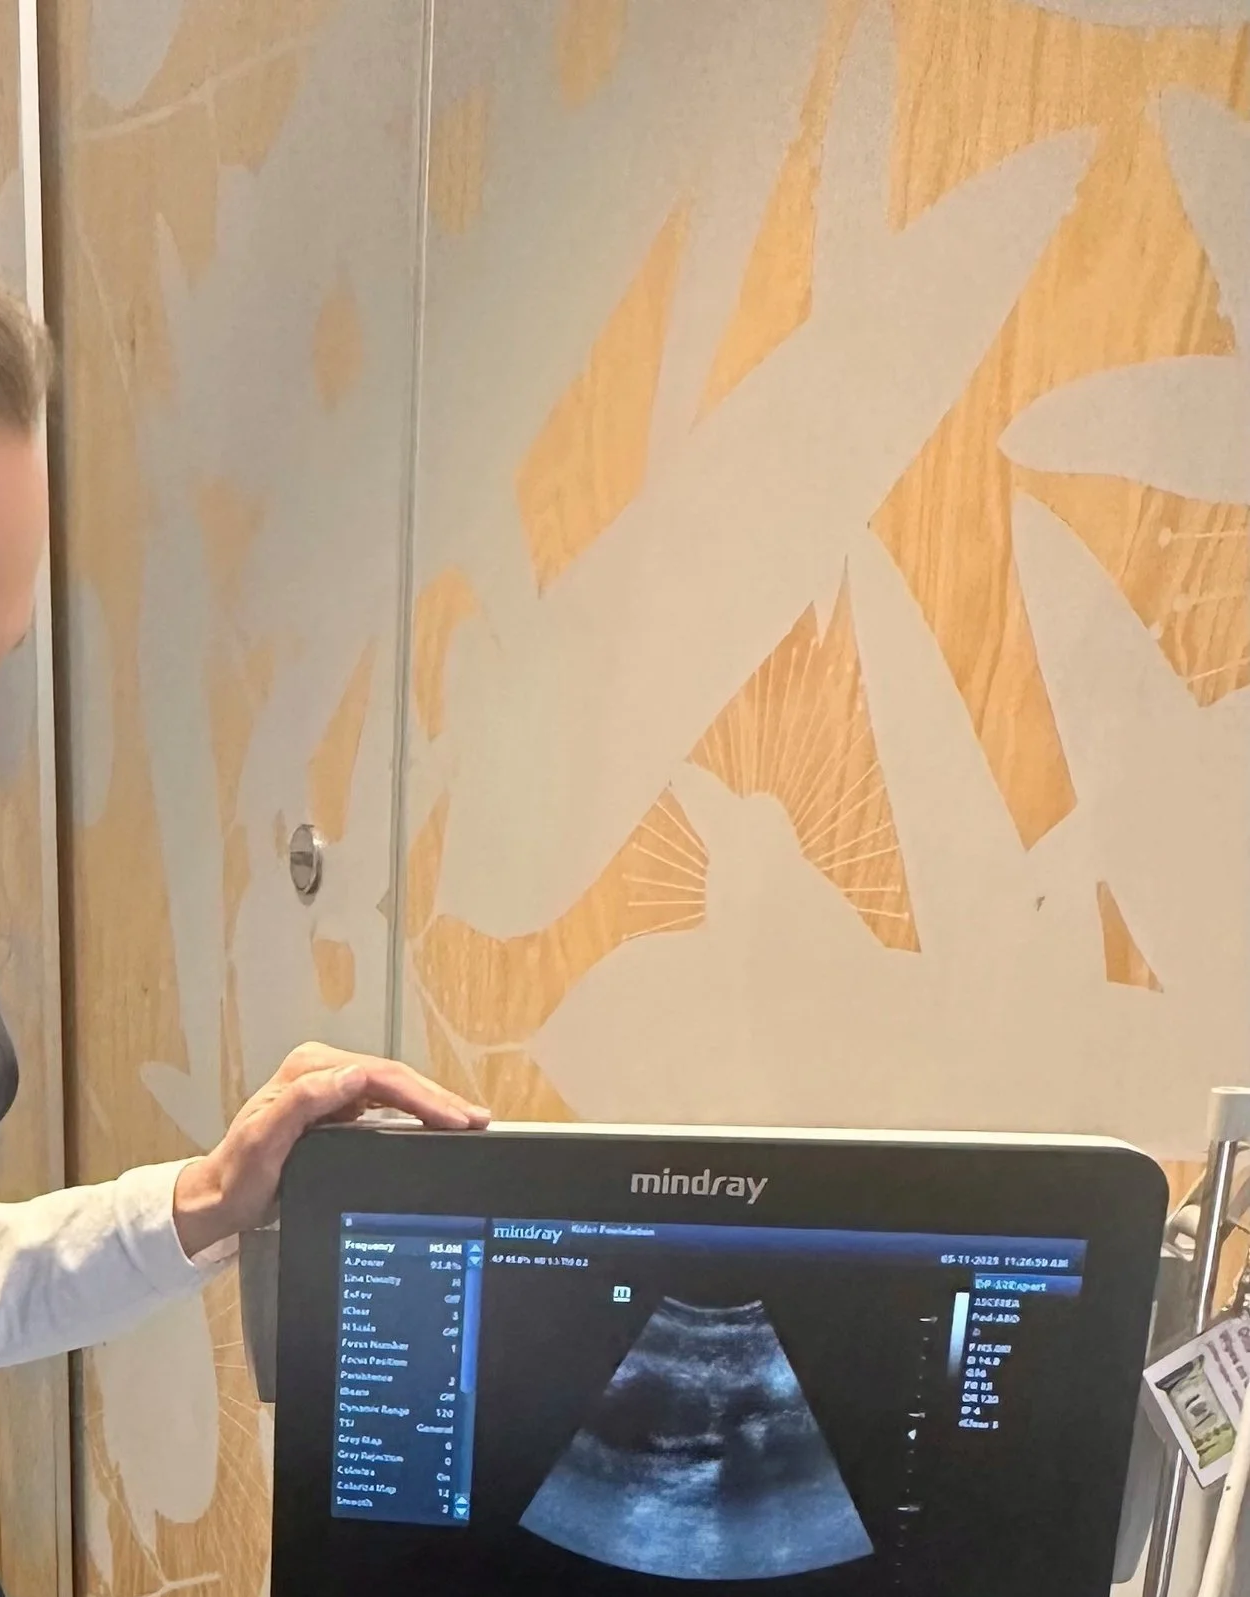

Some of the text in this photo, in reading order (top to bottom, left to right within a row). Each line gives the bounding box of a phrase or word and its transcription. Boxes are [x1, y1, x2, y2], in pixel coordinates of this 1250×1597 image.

[630, 1168, 768, 1204] mindray
[493, 1225, 563, 1244] mindray
[345, 1240, 395, 1253] Frequency
[341, 1354, 408, 1367] Focus Position
[339, 1403, 410, 1417] Dynamic Range
[416, 1423, 454, 1434] General
